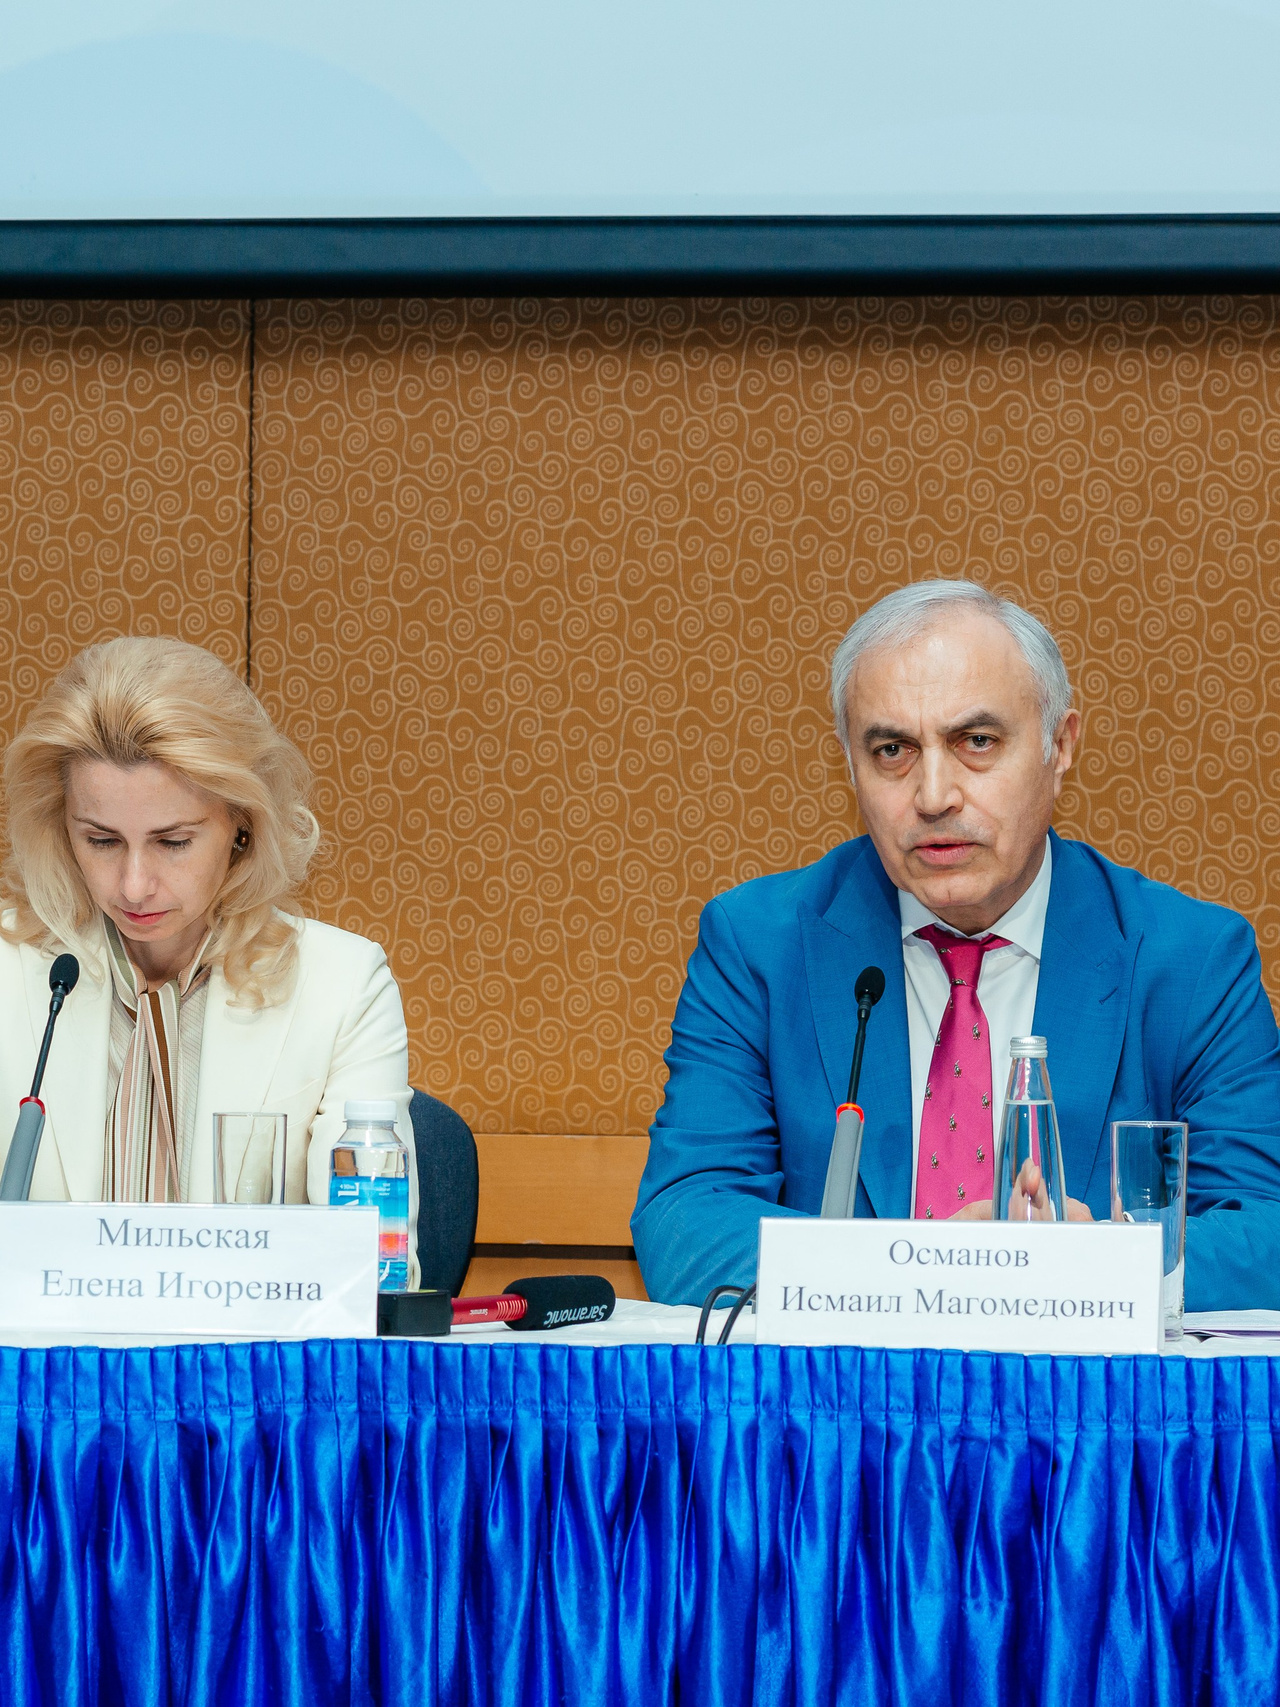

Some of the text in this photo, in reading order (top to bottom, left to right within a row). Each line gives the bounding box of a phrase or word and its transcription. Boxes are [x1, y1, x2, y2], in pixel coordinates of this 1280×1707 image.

[98, 1217, 270, 1249] Мильская
[888, 1239, 1030, 1267] Османов
[42, 1269, 323, 1308] Елена Игоревна
[781, 1285, 1135, 1319] Исмаил Магомедович
[543, 1304, 608, 1328] Saramonic
